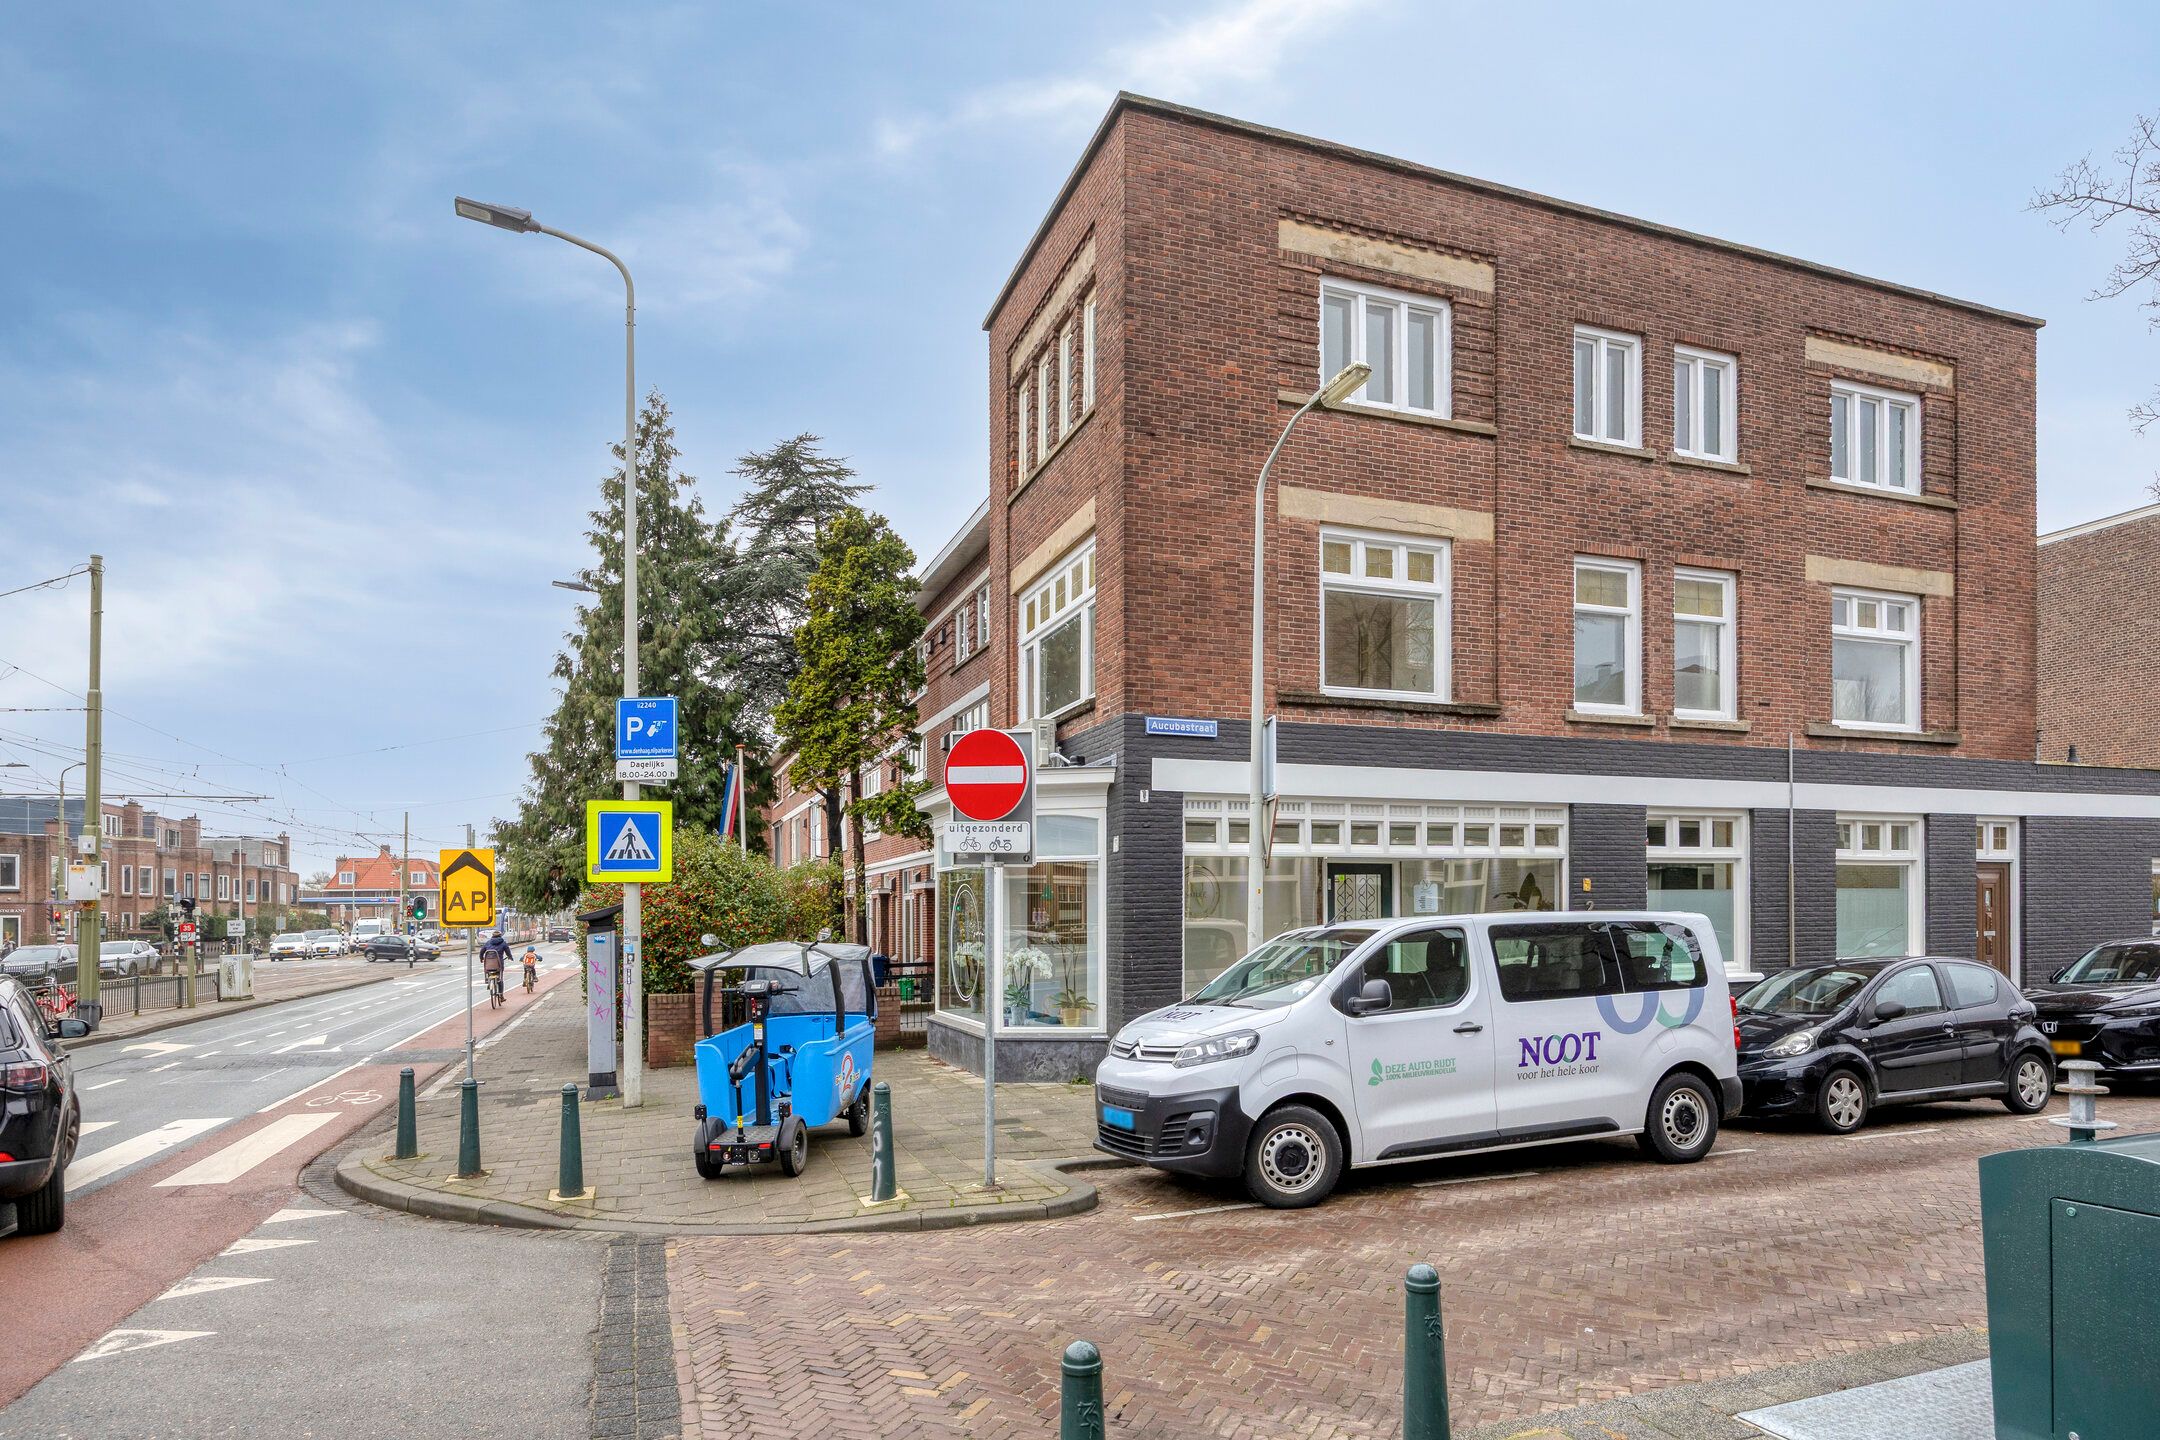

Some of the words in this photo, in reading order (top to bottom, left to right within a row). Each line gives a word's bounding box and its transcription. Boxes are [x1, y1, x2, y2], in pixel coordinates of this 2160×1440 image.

[627, 717, 643, 741] P
[1151, 721, 1214, 733] Aucubastraat
[630, 761, 665, 769] Dagelijks
[949, 824, 1023, 835] uitgezonderd
[1518, 1031, 1601, 1068] NOOT
[1385, 1063, 1406, 1074] DEZE
[1408, 1060, 1432, 1072] AUTO
[1517, 1070, 1538, 1080] voor
[1540, 1067, 1555, 1078] het
[1557, 1066, 1577, 1077] hele
[1579, 1063, 1600, 1074] koor
[1386, 1072, 1401, 1080] 100%
